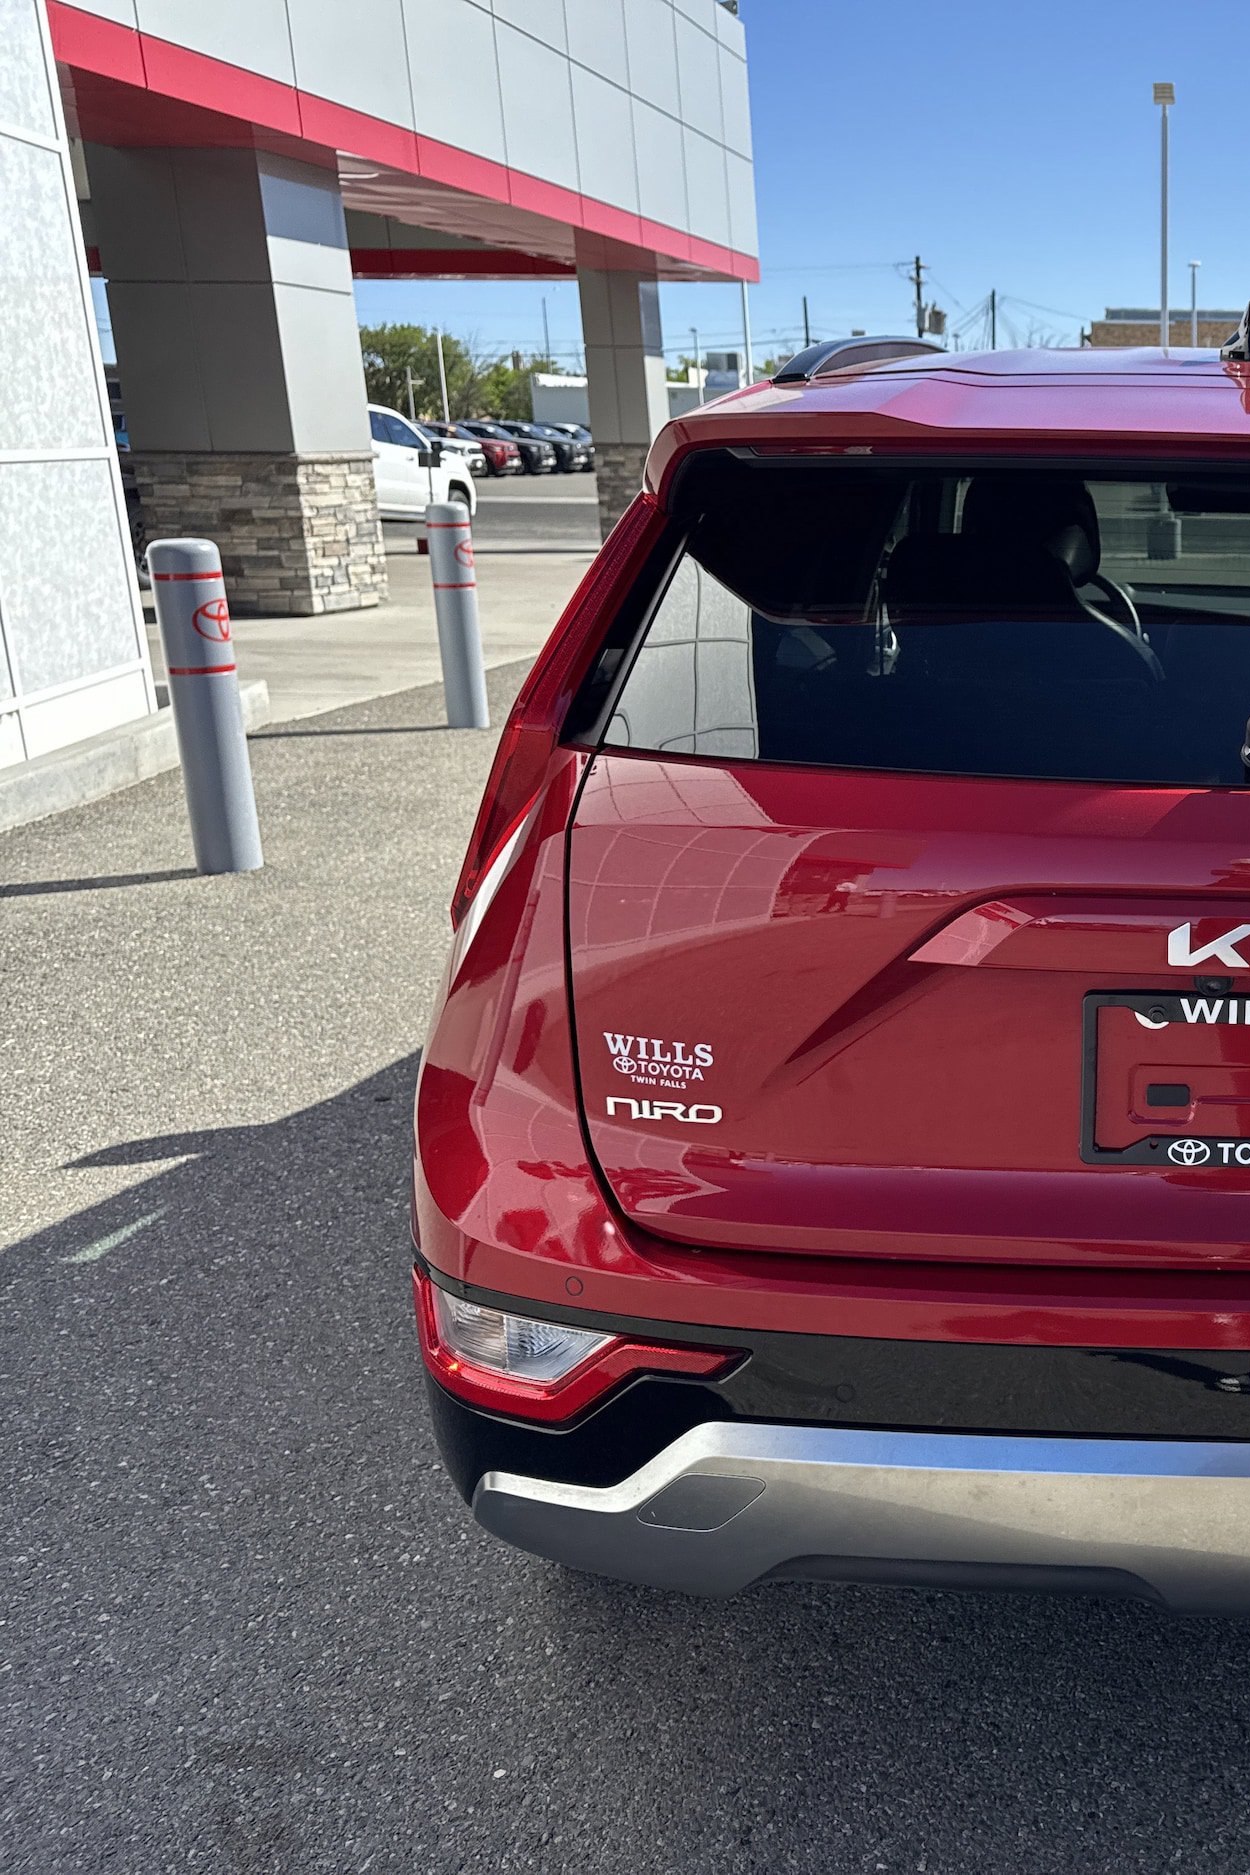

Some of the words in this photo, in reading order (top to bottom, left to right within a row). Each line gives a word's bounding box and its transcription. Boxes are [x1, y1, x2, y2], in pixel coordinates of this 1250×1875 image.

[603, 1032, 714, 1067] WILLS
[637, 1060, 704, 1081] TOYOTA
[631, 1075, 657, 1086] TWIN
[660, 1079, 687, 1090] FALLS
